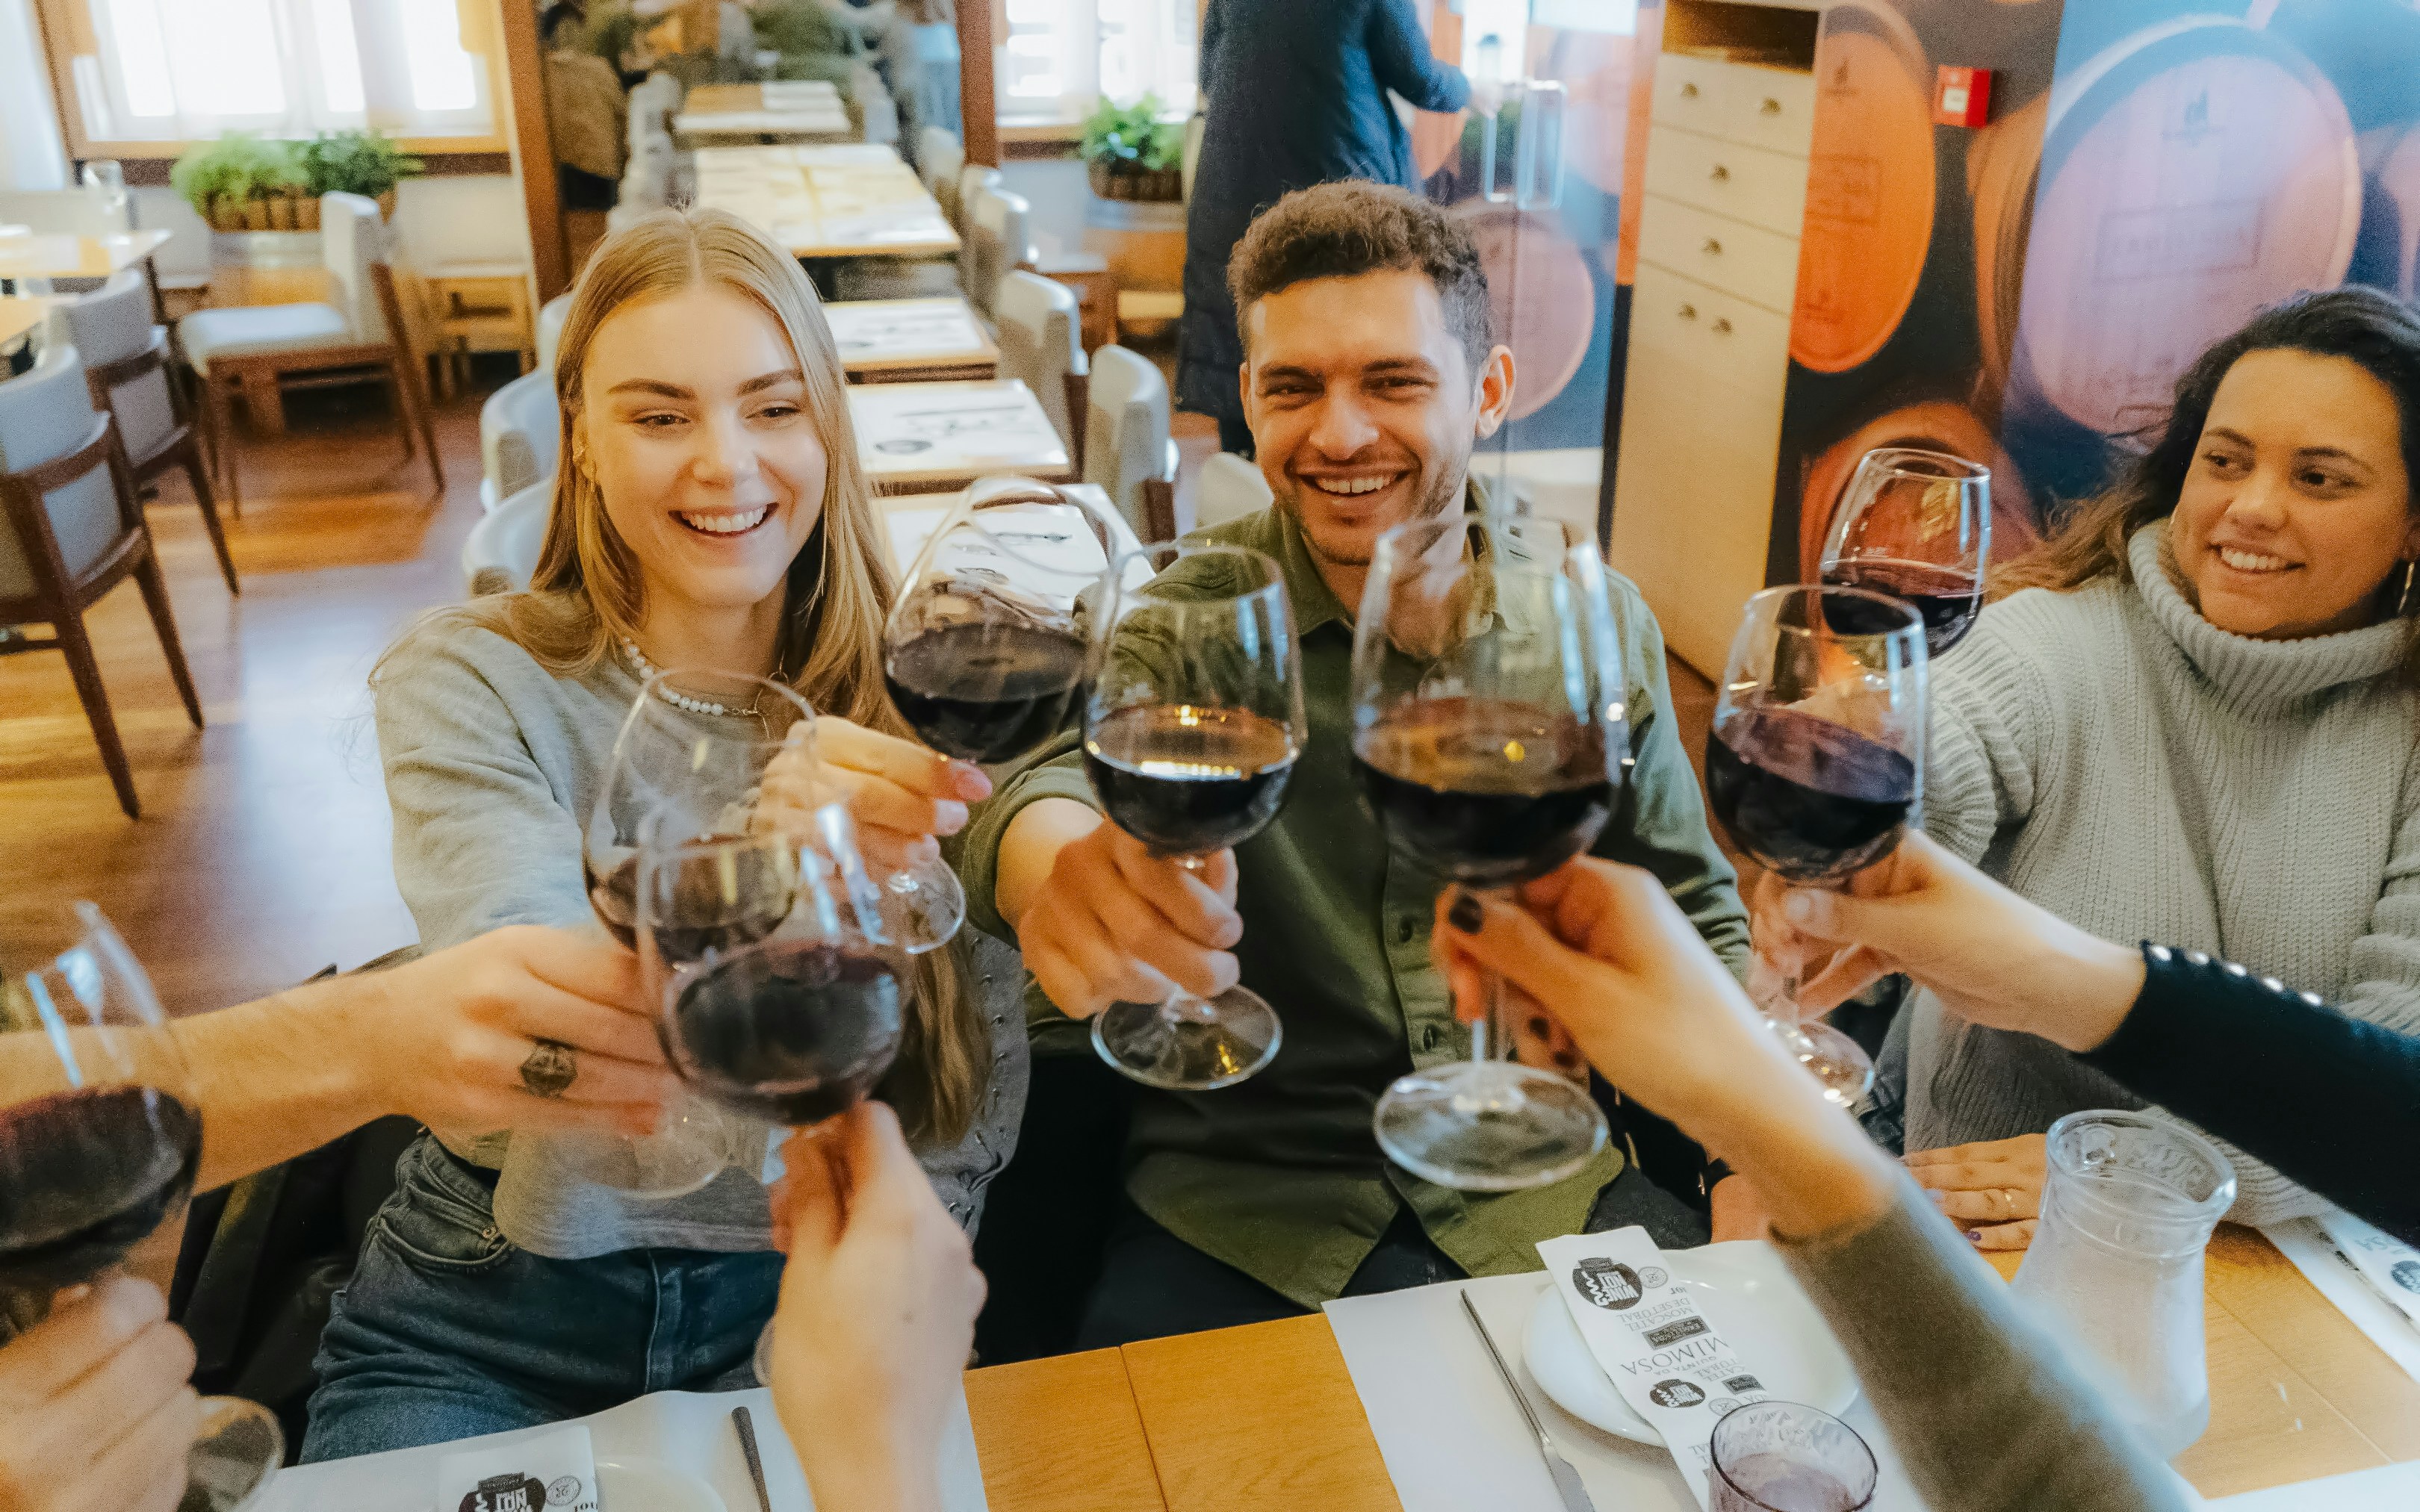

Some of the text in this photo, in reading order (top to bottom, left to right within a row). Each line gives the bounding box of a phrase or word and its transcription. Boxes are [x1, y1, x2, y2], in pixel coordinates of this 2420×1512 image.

[1598, 1274, 1628, 1289] NOT
[1603, 1284, 1639, 1302] WINE
[1620, 1337, 1731, 1375] MIMOSA
